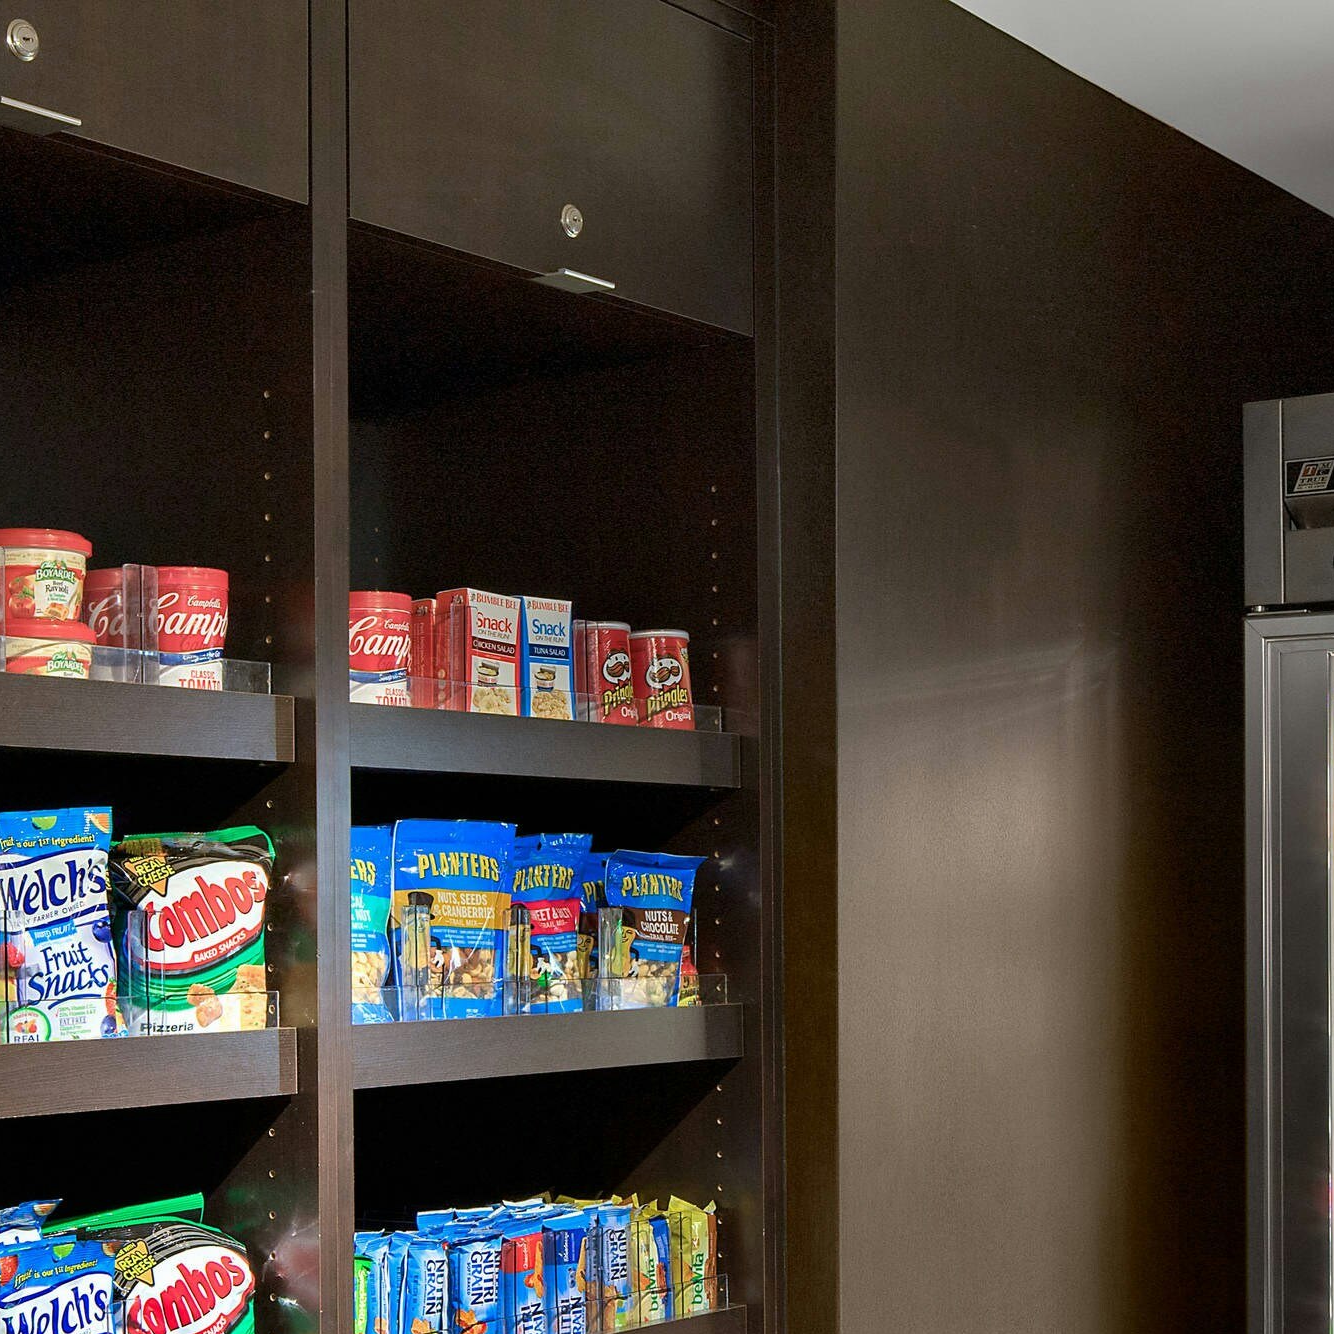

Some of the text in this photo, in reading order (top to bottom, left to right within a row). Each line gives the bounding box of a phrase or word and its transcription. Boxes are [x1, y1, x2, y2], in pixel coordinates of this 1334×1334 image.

[476, 592, 503, 607] BUMBLE
[532, 600, 558, 612] BUMBLE
[476, 611, 512, 634] Snack
[532, 619, 566, 637] Snack
[136, 855, 166, 875] REAL
[137, 864, 175, 886] CHEESE
[418, 851, 500, 882] PLANTERS
[513, 864, 574, 893] PLANTERS
[621, 874, 684, 902] PLANTERS
[141, 870, 266, 952] Combos
[460, 894, 488, 906] SEEDS
[644, 910, 666, 922] NUTS
[640, 920, 680, 935] CHOCOLATE
[43, 940, 93, 977] Fruit
[193, 947, 217, 964] BAKED
[28, 962, 109, 1005] Snacks
[119, 1250, 147, 1272] REAL
[470, 1250, 484, 1306] GRAIN
[691, 1252, 705, 1305] belVita
